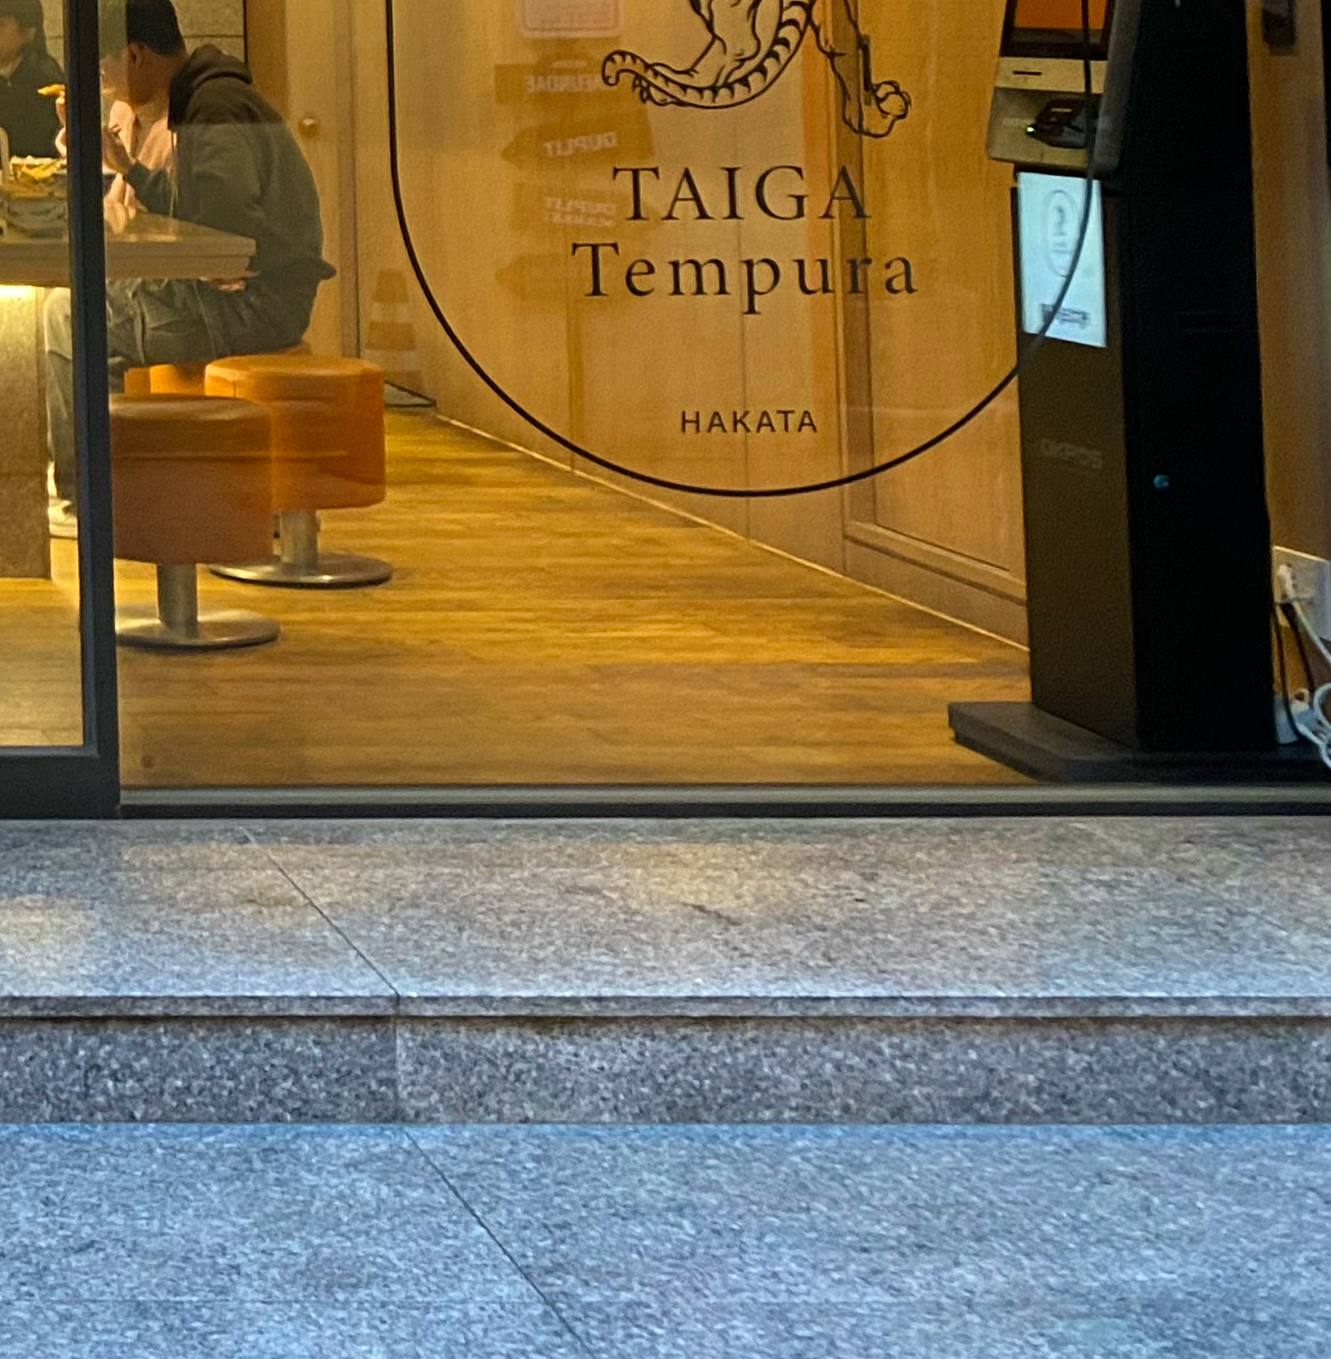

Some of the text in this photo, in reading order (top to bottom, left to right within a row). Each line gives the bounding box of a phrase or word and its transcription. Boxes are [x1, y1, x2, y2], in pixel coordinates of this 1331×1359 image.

[612, 164, 871, 222] TAIGA
[571, 241, 919, 316] Tempura
[680, 410, 818, 434] HAKATA
